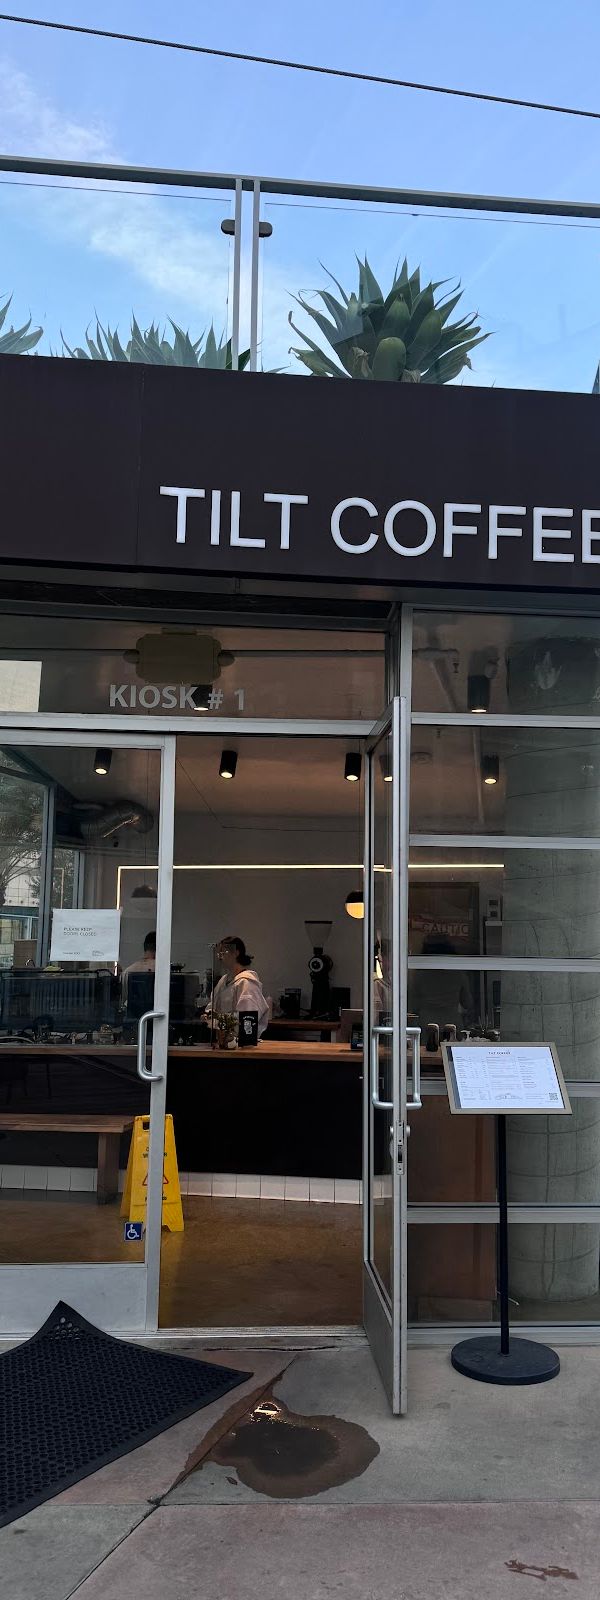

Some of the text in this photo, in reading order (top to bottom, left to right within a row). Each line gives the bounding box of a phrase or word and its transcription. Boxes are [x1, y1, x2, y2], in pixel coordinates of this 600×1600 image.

[159, 485, 309, 550] TILT
[109, 684, 246, 711] KIOSK # 1
